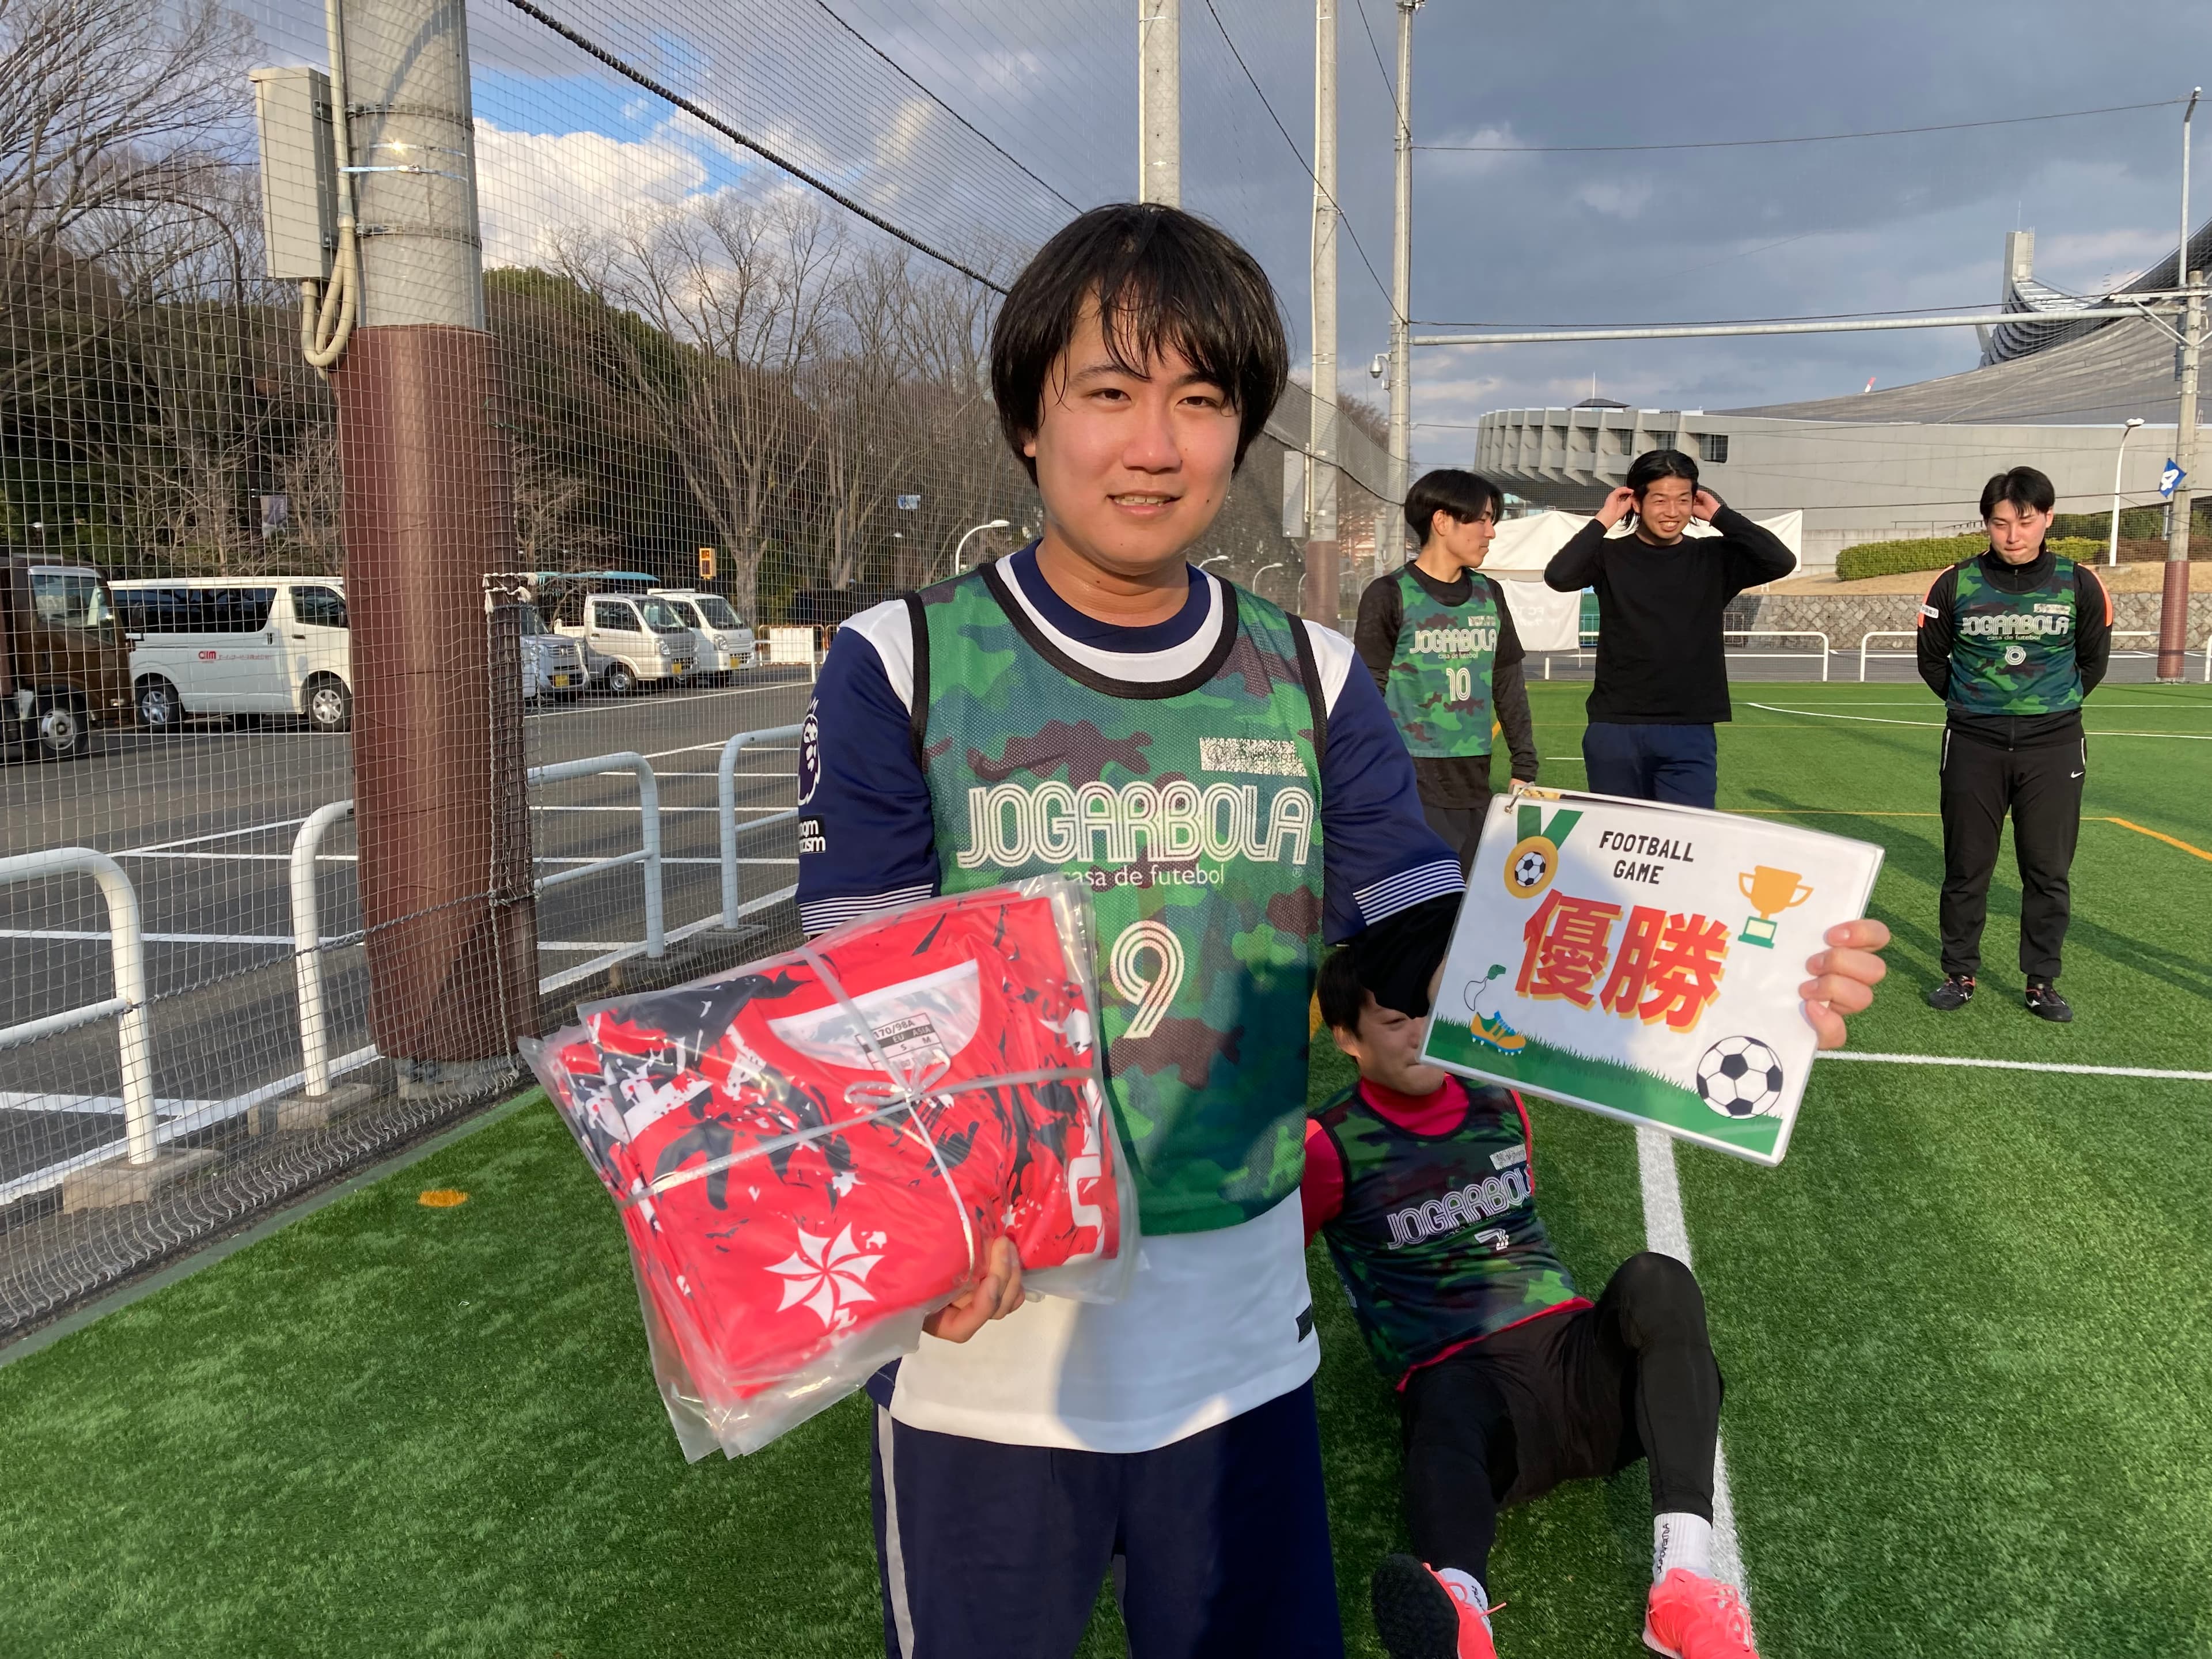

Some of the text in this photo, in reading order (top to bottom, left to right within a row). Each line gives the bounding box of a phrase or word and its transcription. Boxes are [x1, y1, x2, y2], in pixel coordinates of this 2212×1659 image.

[1960, 614, 2069, 636] JOGARBOLA
[1410, 628, 1497, 654] JOGARBOLA
[1446, 667, 1471, 701] 10
[957, 781, 1313, 868] JOGARBOLA
[1599, 830, 1694, 862] FOOTBALL
[1115, 865, 1143, 886] de
[1152, 864, 1225, 886] futebol
[1613, 859, 1664, 884] GAME
[1514, 888, 1730, 1033] 優勝
[1110, 920, 1184, 1039] 9
[893, 1027, 931, 1043] EU ASIA
